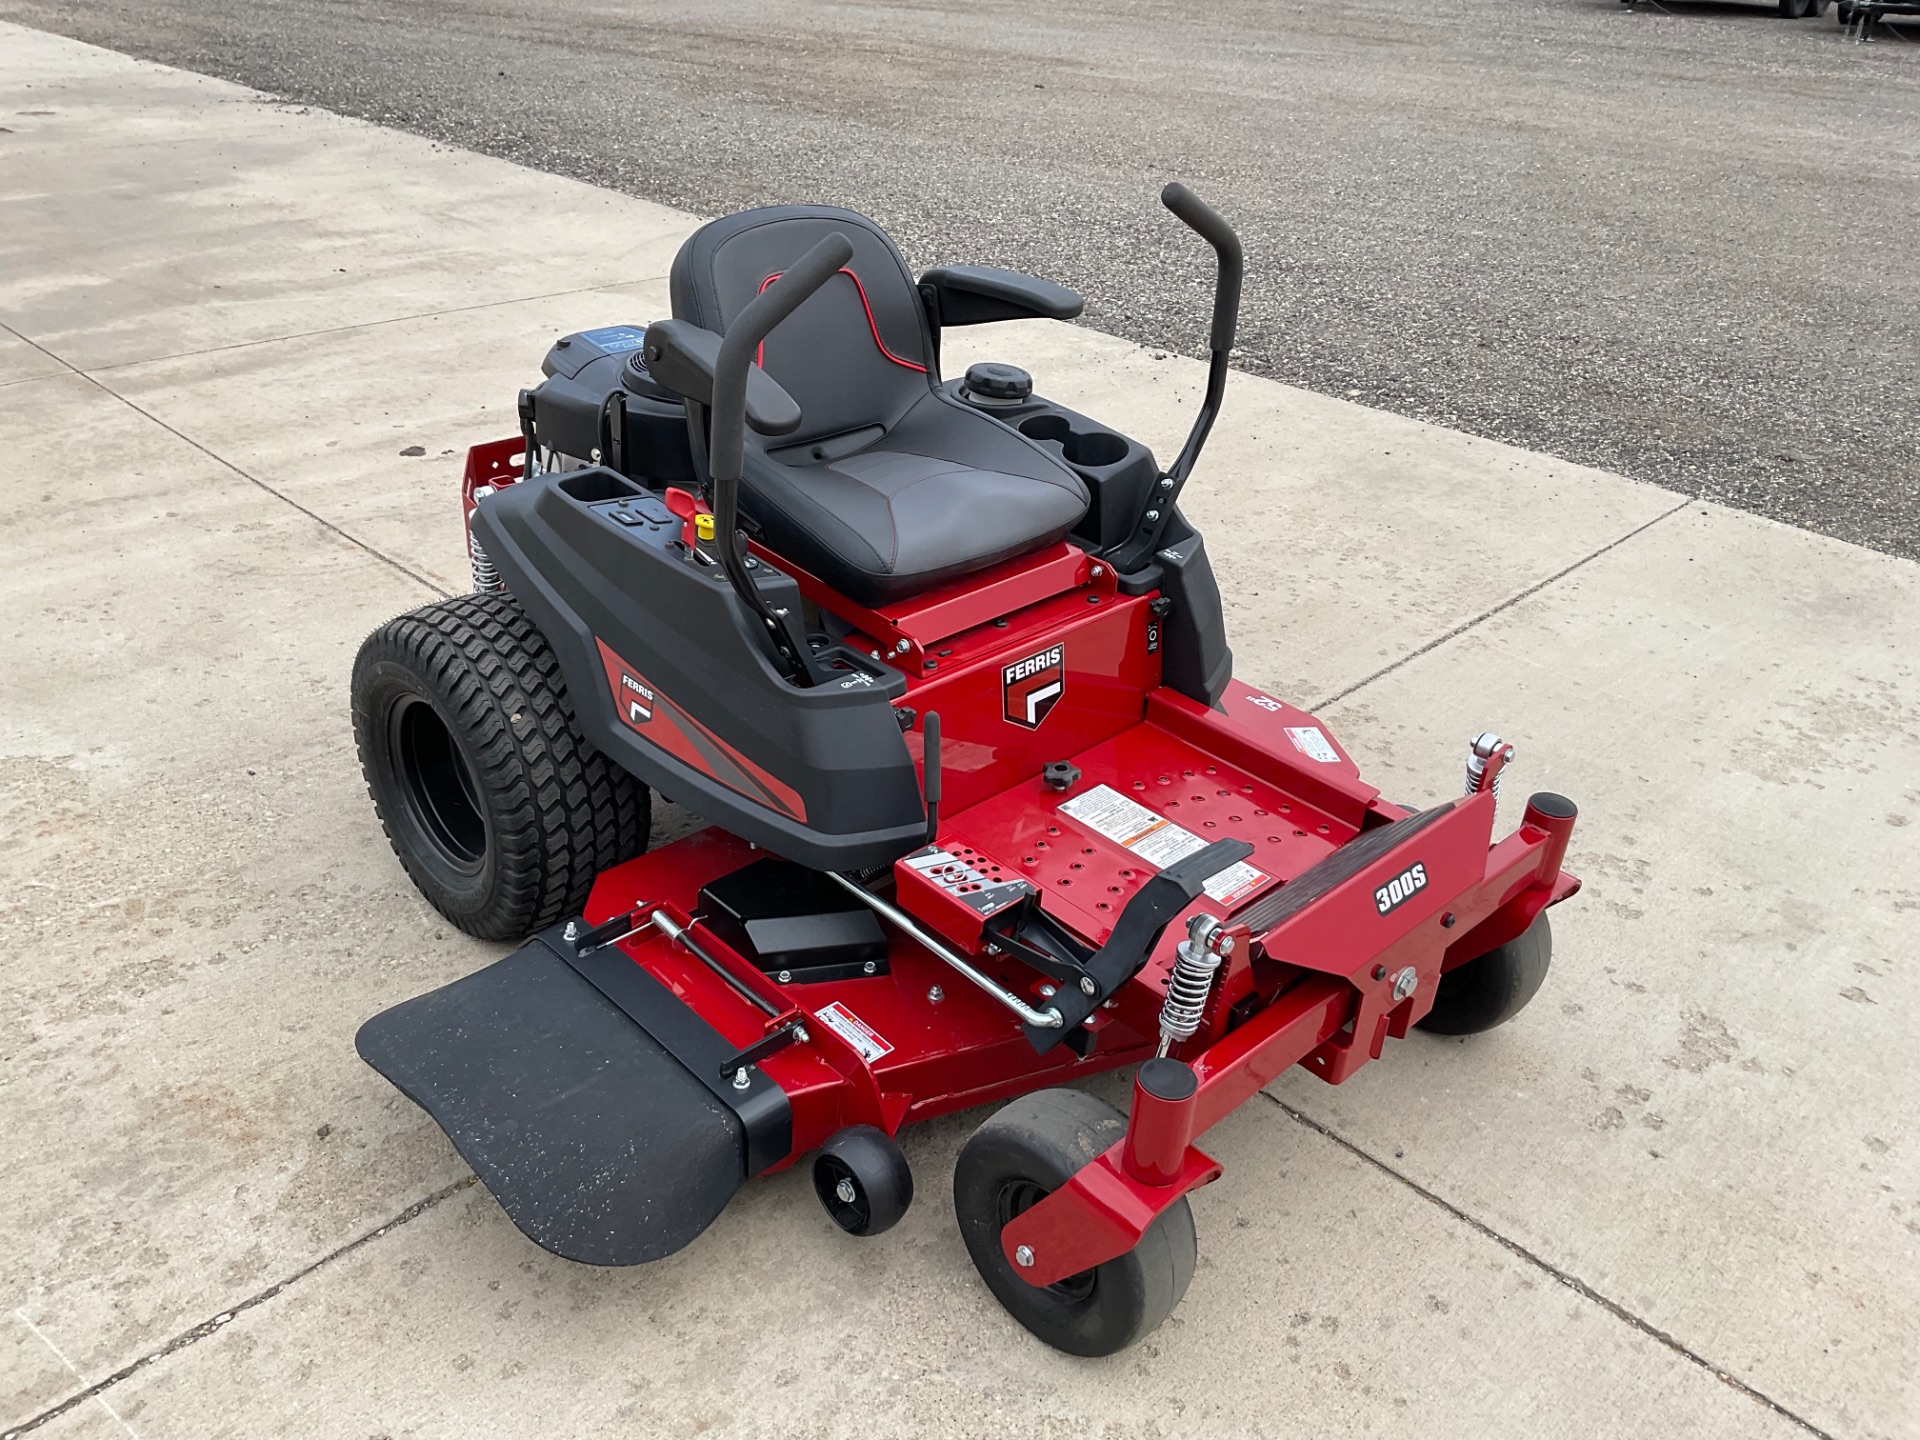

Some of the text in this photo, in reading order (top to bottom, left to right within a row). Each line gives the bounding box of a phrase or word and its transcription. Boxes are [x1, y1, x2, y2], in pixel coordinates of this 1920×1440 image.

[1006, 648, 1061, 684] FERRIS
[622, 674, 654, 701] FERRIS
[1376, 863, 1427, 912] 300S
[853, 1020, 874, 1037] DANGER
